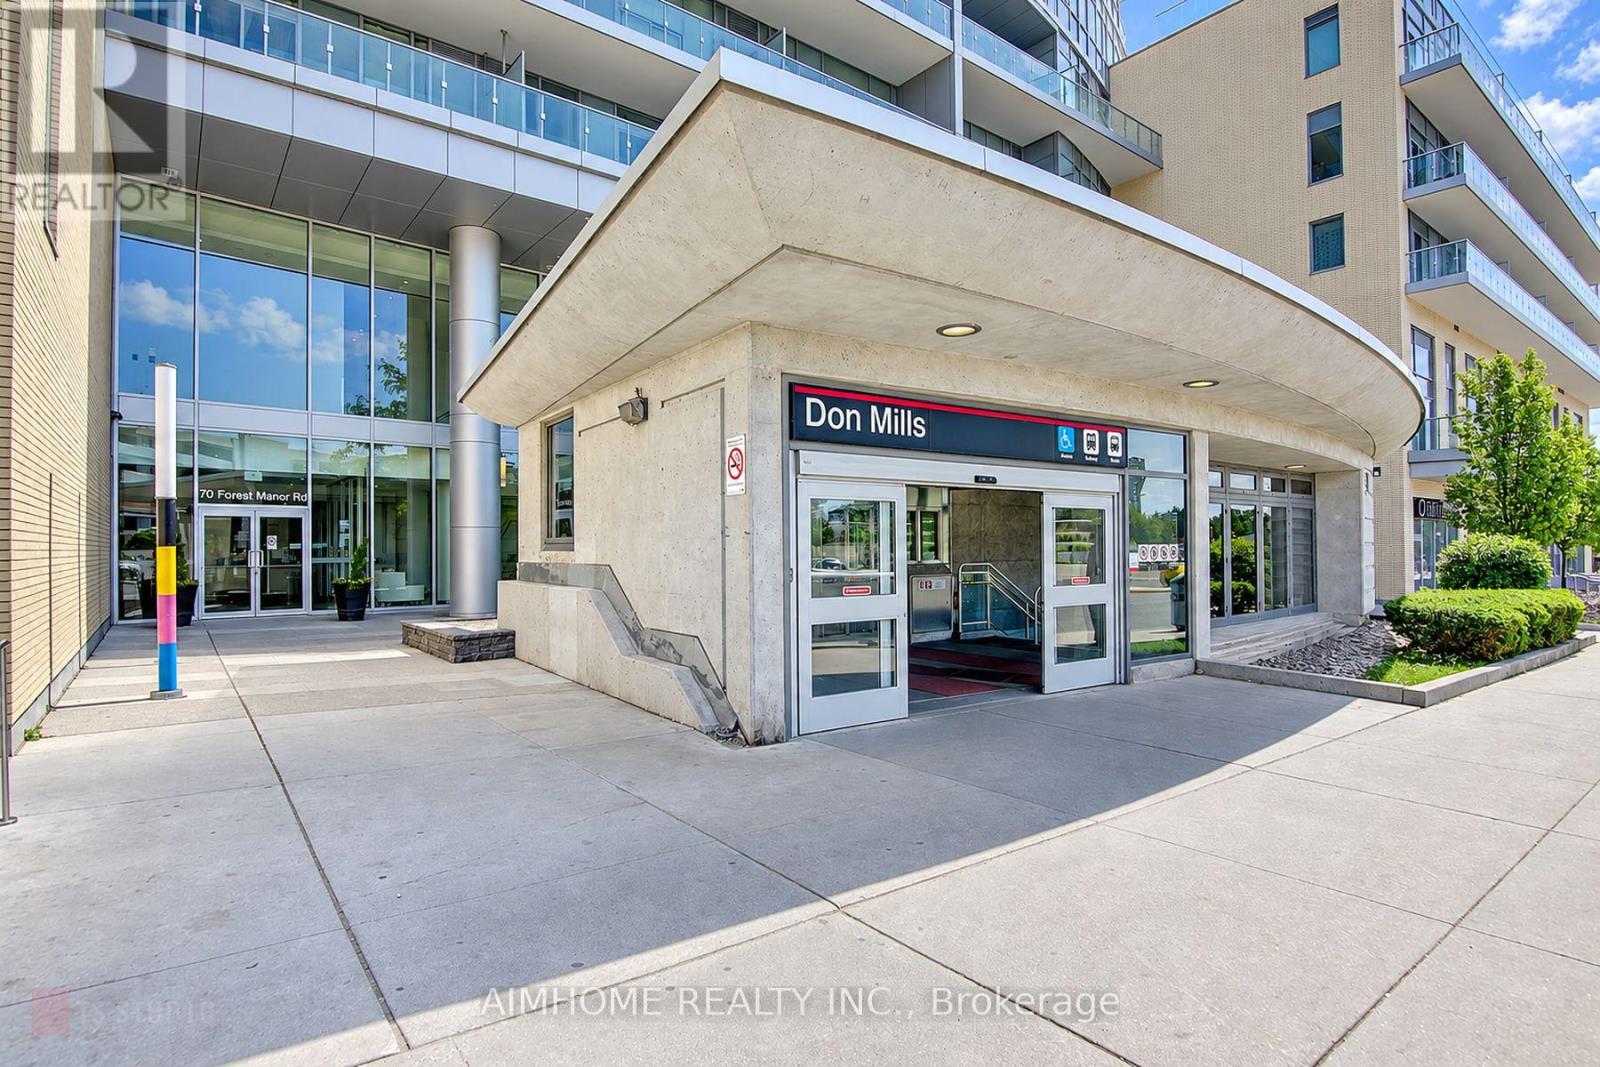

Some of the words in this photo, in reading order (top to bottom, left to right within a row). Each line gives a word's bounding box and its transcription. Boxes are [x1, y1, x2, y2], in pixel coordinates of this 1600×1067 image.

[805, 396, 861, 431] Don
[870, 404, 927, 438] Mills
[199, 489, 214, 499] 70
[217, 490, 253, 500] Forest
[256, 491, 290, 502] Manor
[293, 492, 308, 502] Rd
